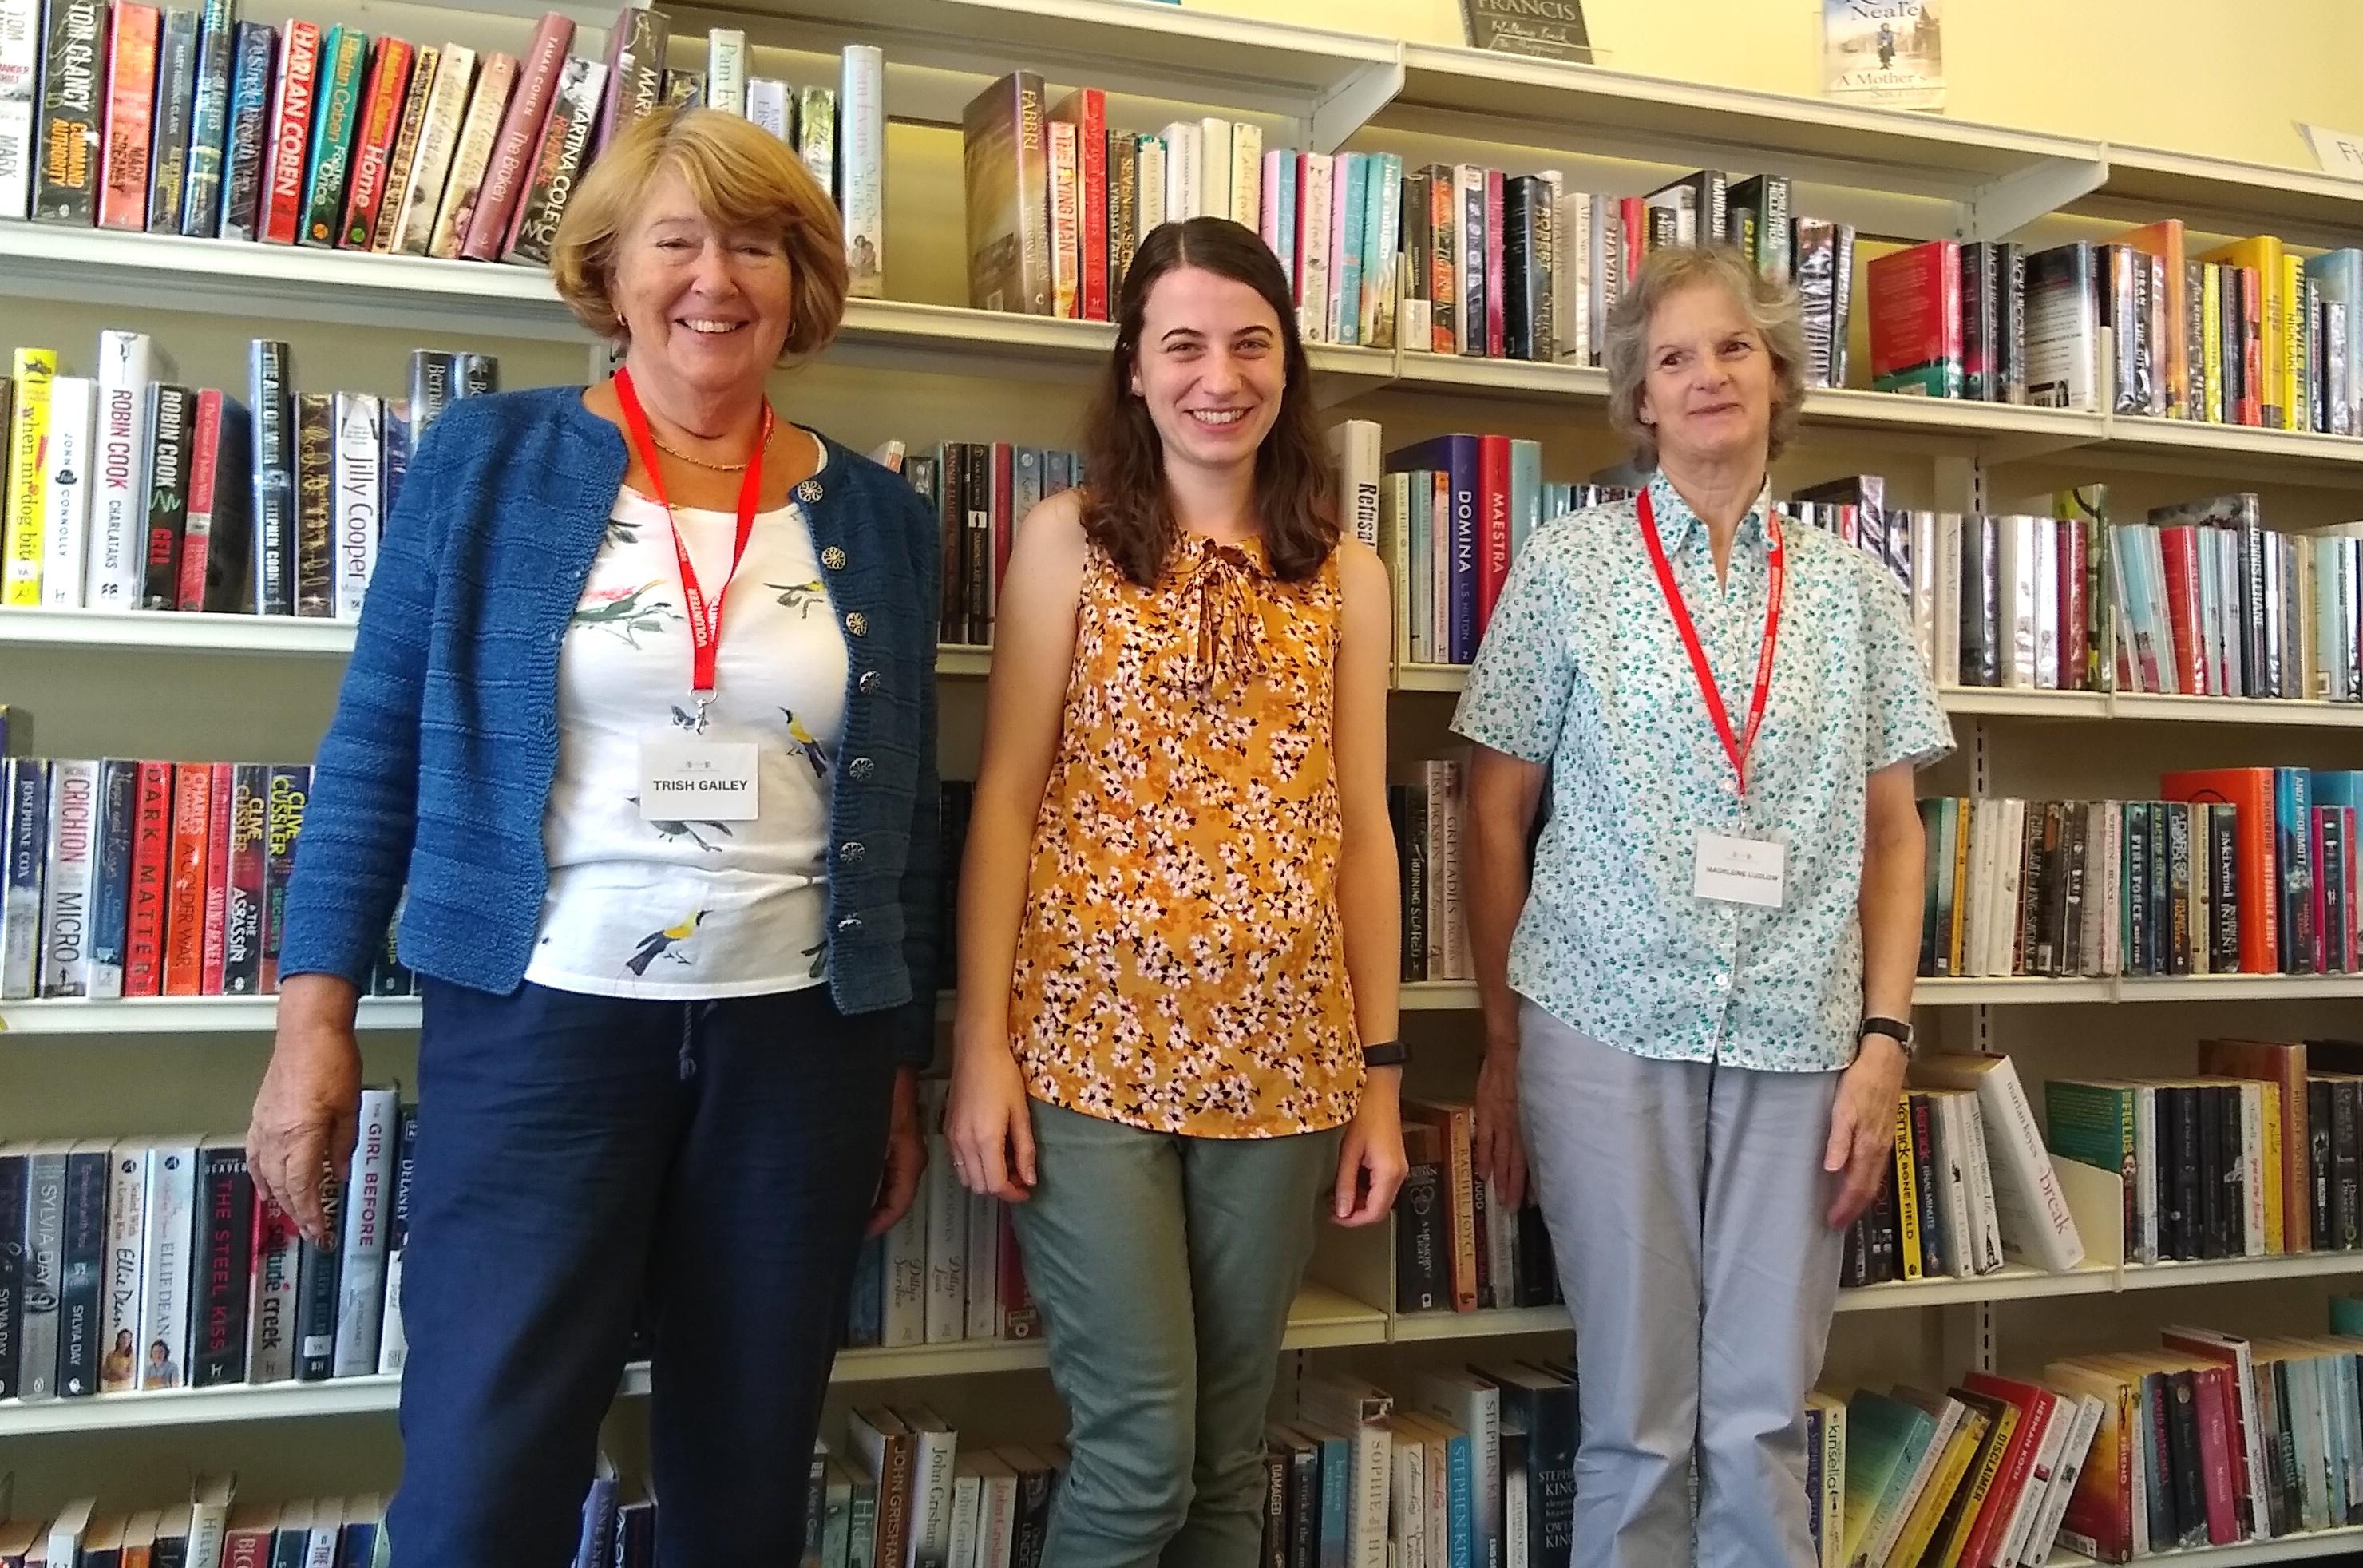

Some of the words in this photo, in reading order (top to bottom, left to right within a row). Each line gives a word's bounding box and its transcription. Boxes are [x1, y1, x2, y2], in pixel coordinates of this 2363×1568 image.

[67, 4, 94, 40] TOM
[1852, 2, 1918, 20] Neale
[64, 46, 93, 112] CLANCY
[283, 30, 312, 118] HARLAN
[338, 38, 357, 86] Harlan
[719, 43, 738, 82] Pam
[328, 89, 350, 142] Coben
[558, 97, 594, 171] MARTINA
[1022, 89, 1039, 150] FABBRI
[49, 118, 69, 187] AUTHORITY
[275, 123, 303, 196] COBEN
[356, 145, 383, 208] Home
[542, 176, 571, 229] COLE
[1122, 158, 1134, 203] SEVEN
[1058, 217, 1075, 253] MAN
[1605, 231, 1617, 306] HAYDER
[21, 406, 38, 457] when
[109, 389, 133, 437] ROBIN
[160, 390, 183, 439] ROBIN
[64, 433, 74, 465] JOHN
[106, 442, 131, 489] COOK
[154, 443, 180, 489] COOK
[342, 453, 374, 497] Jilly
[15, 491, 38, 526] dog
[58, 489, 71, 557] CONNOLLY
[1459, 489, 1473, 573] DOMINA
[1492, 492, 1506, 573] MAESTRA
[105, 500, 121, 569] CHARLATANS
[343, 502, 374, 581] Cooper
[687, 588, 708, 648] VOLUNTEER
[1461, 601, 1470, 640] HILTON
[142, 767, 164, 841] DARK
[653, 781, 695, 790] TRISH
[699, 780, 748, 791] GAILEY
[1431, 770, 1442, 796] LISA
[2294, 776, 2305, 802] ANDY
[18, 779, 36, 846] JOSEPHINE
[58, 778, 90, 862] CRICHTON
[233, 783, 250, 853] CUSSLER
[247, 798, 264, 839] CLIVE
[269, 777, 289, 856] CUSSLER
[286, 790, 306, 838] CLIVE
[1431, 801, 1442, 860] JACKSON
[17, 851, 30, 878] COX
[2131, 834, 2142, 873] FIRE
[178, 858, 194, 924] COLDER
[1411, 857, 1421, 905] RUNNING
[2132, 875, 2143, 921] FORCE
[53, 892, 83, 963] MICRO
[136, 865, 158, 976] MATTER
[229, 886, 247, 961] ASSASSIN
[246, 914, 257, 936] THE
[1410, 907, 1423, 958] SCARED
[176, 928, 192, 967] WAR
[366, 1123, 383, 1166] GIRL
[2122, 1103, 2132, 1154] FIELDS
[216, 1179, 232, 1222] THE
[398, 1159, 414, 1221] DELANEY
[1460, 1148, 1470, 1205] RACHEL
[1475, 1180, 1484, 1210] JUDD
[1902, 1162, 1913, 1199] BONE
[1922, 1165, 1933, 1193] FINAL
[39, 1184, 58, 1245] SYLVIA
[360, 1172, 379, 1247] BEFORE
[1905, 1202, 1914, 1240] FIELD
[1926, 1194, 1936, 1230] MINUTE
[2038, 1166, 2070, 1237] break
[1463, 1214, 1474, 1258] JOYCE
[37, 1250, 54, 1285] DAY
[116, 1248, 135, 1286] Ellie
[159, 1242, 175, 1285] ELLIE
[212, 1230, 232, 1296] STEEL
[71, 1305, 84, 1343] SYLVIA
[113, 1289, 133, 1328] Dean
[157, 1289, 172, 1335] DEAN
[210, 1305, 227, 1351] KISS
[261, 1296, 284, 1351] creek
[70, 1344, 82, 1366] DAY
[1486, 1400, 1498, 1478] STEPHEN
[2025, 1400, 2047, 1448] HERMAN
[891, 1446, 907, 1491] JOHN
[931, 1447, 948, 1483] John
[1369, 1439, 1384, 1512] SOPHIE
[1827, 1425, 1840, 1491] kinsella
[1973, 1432, 2008, 1503] DISCLAIMER
[2012, 1449, 2029, 1481] KOCH
[1270, 1463, 1283, 1515] DAMAGED
[1453, 1446, 1467, 1528] STEPHEN
[1545, 1481, 1577, 1496] KING
[925, 1487, 944, 1550] Grisham
